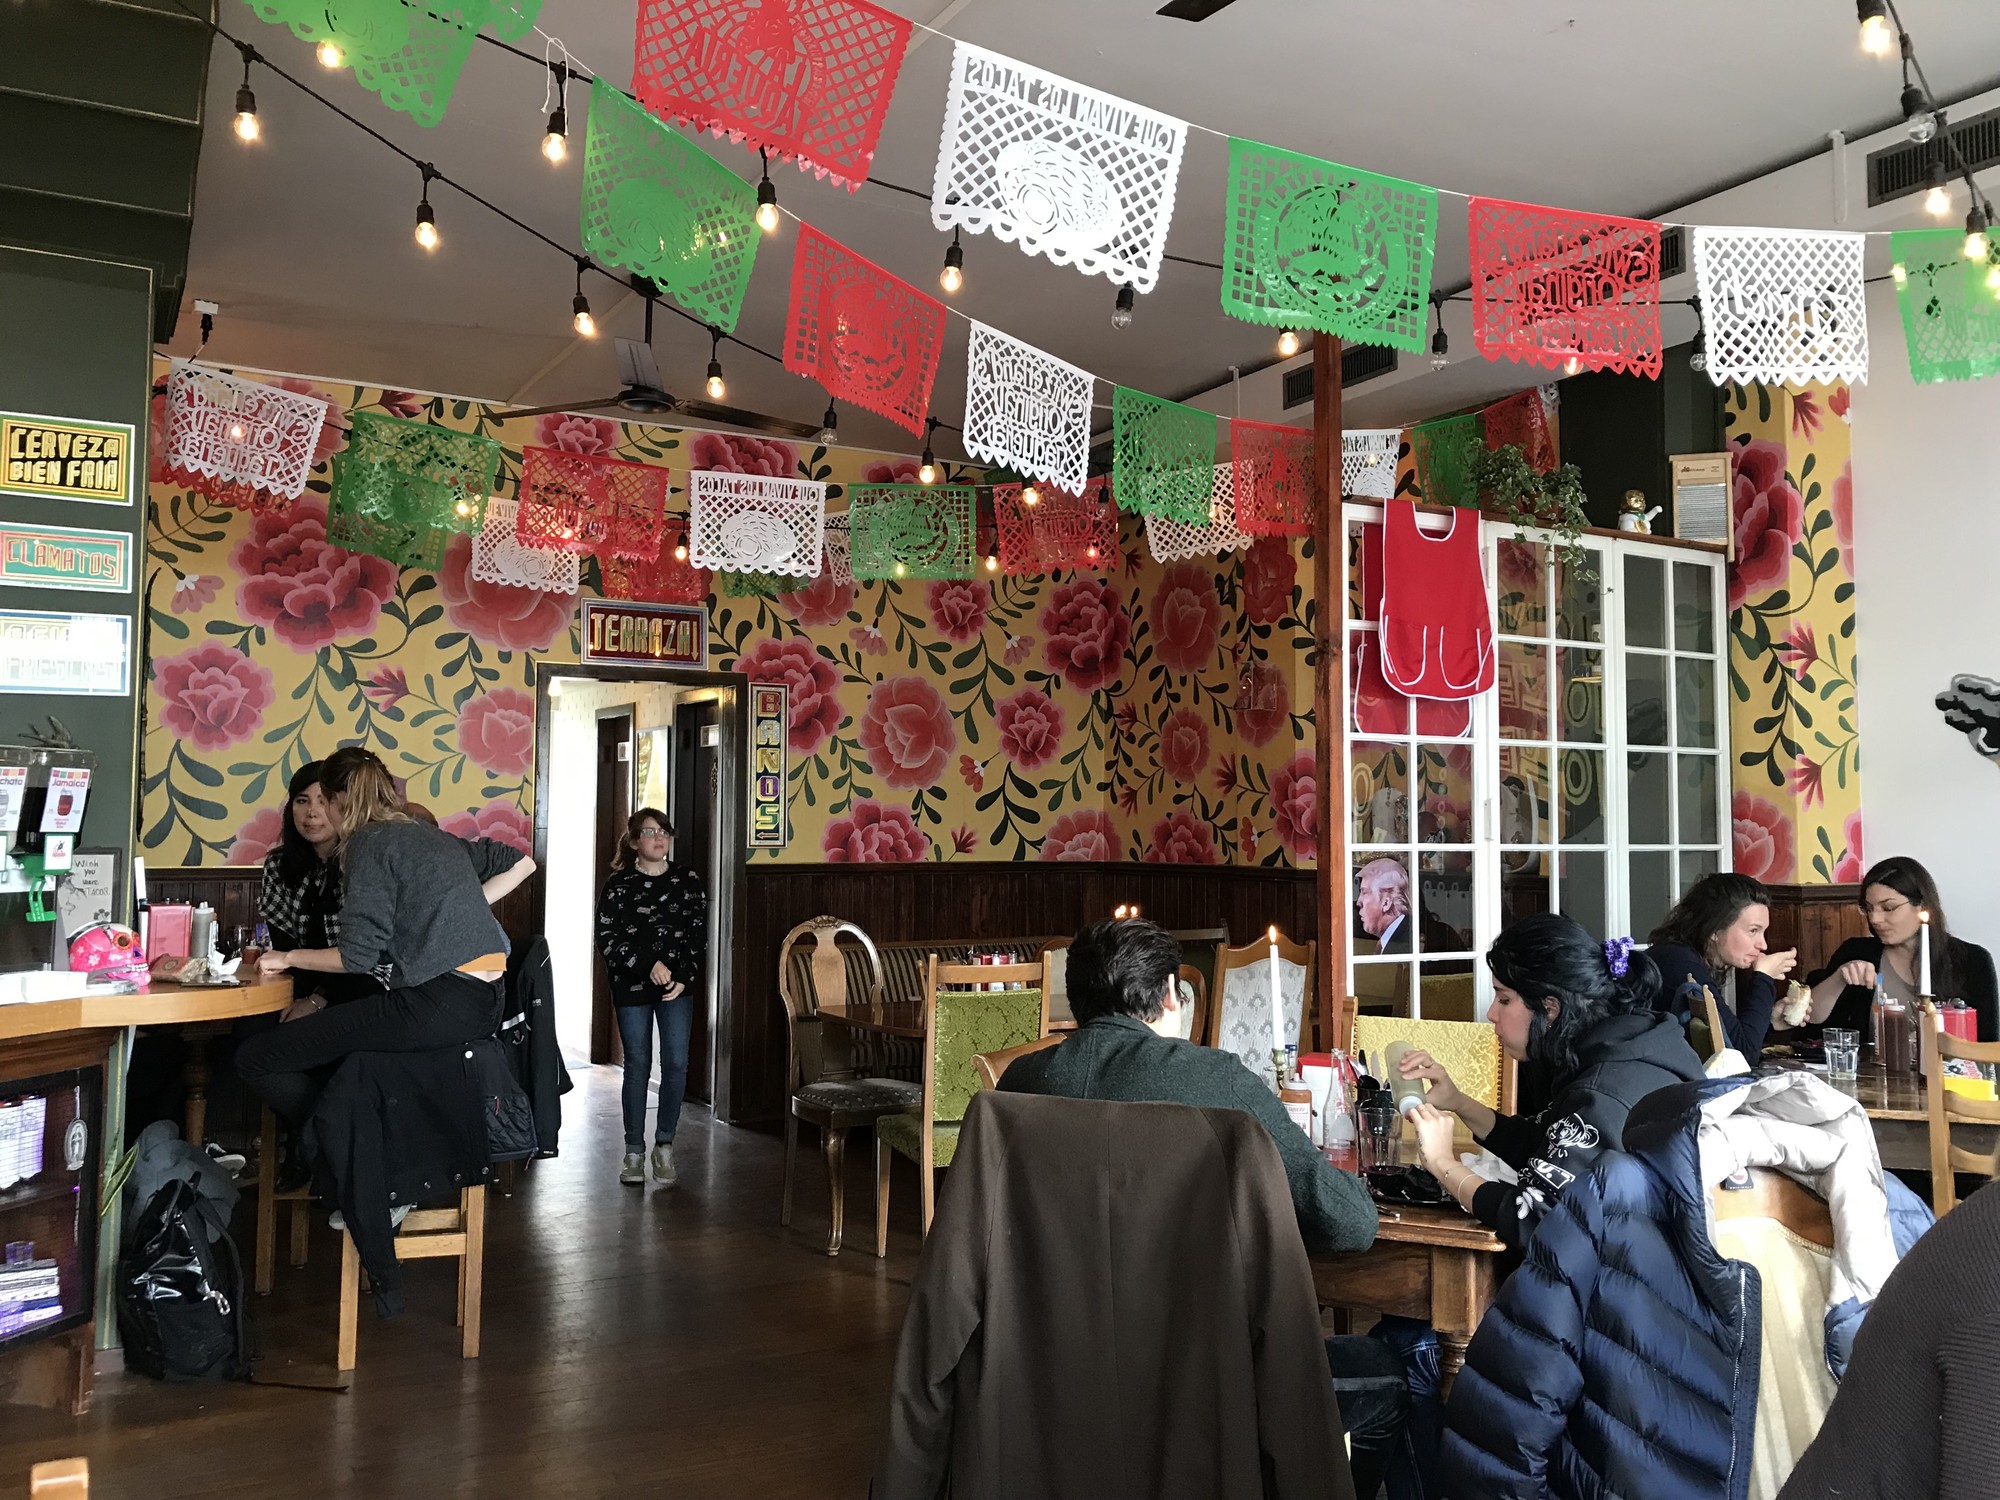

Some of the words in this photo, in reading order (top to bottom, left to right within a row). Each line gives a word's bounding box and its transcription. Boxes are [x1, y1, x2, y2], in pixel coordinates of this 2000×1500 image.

[11, 428, 119, 460] CERVEZA
[9, 460, 61, 485] BIEN
[67, 462, 117, 490] FRIA
[6, 538, 117, 579] CLAMATOS
[591, 612, 690, 654] TERRAZA
[52, 779, 86, 788] Jamaica
